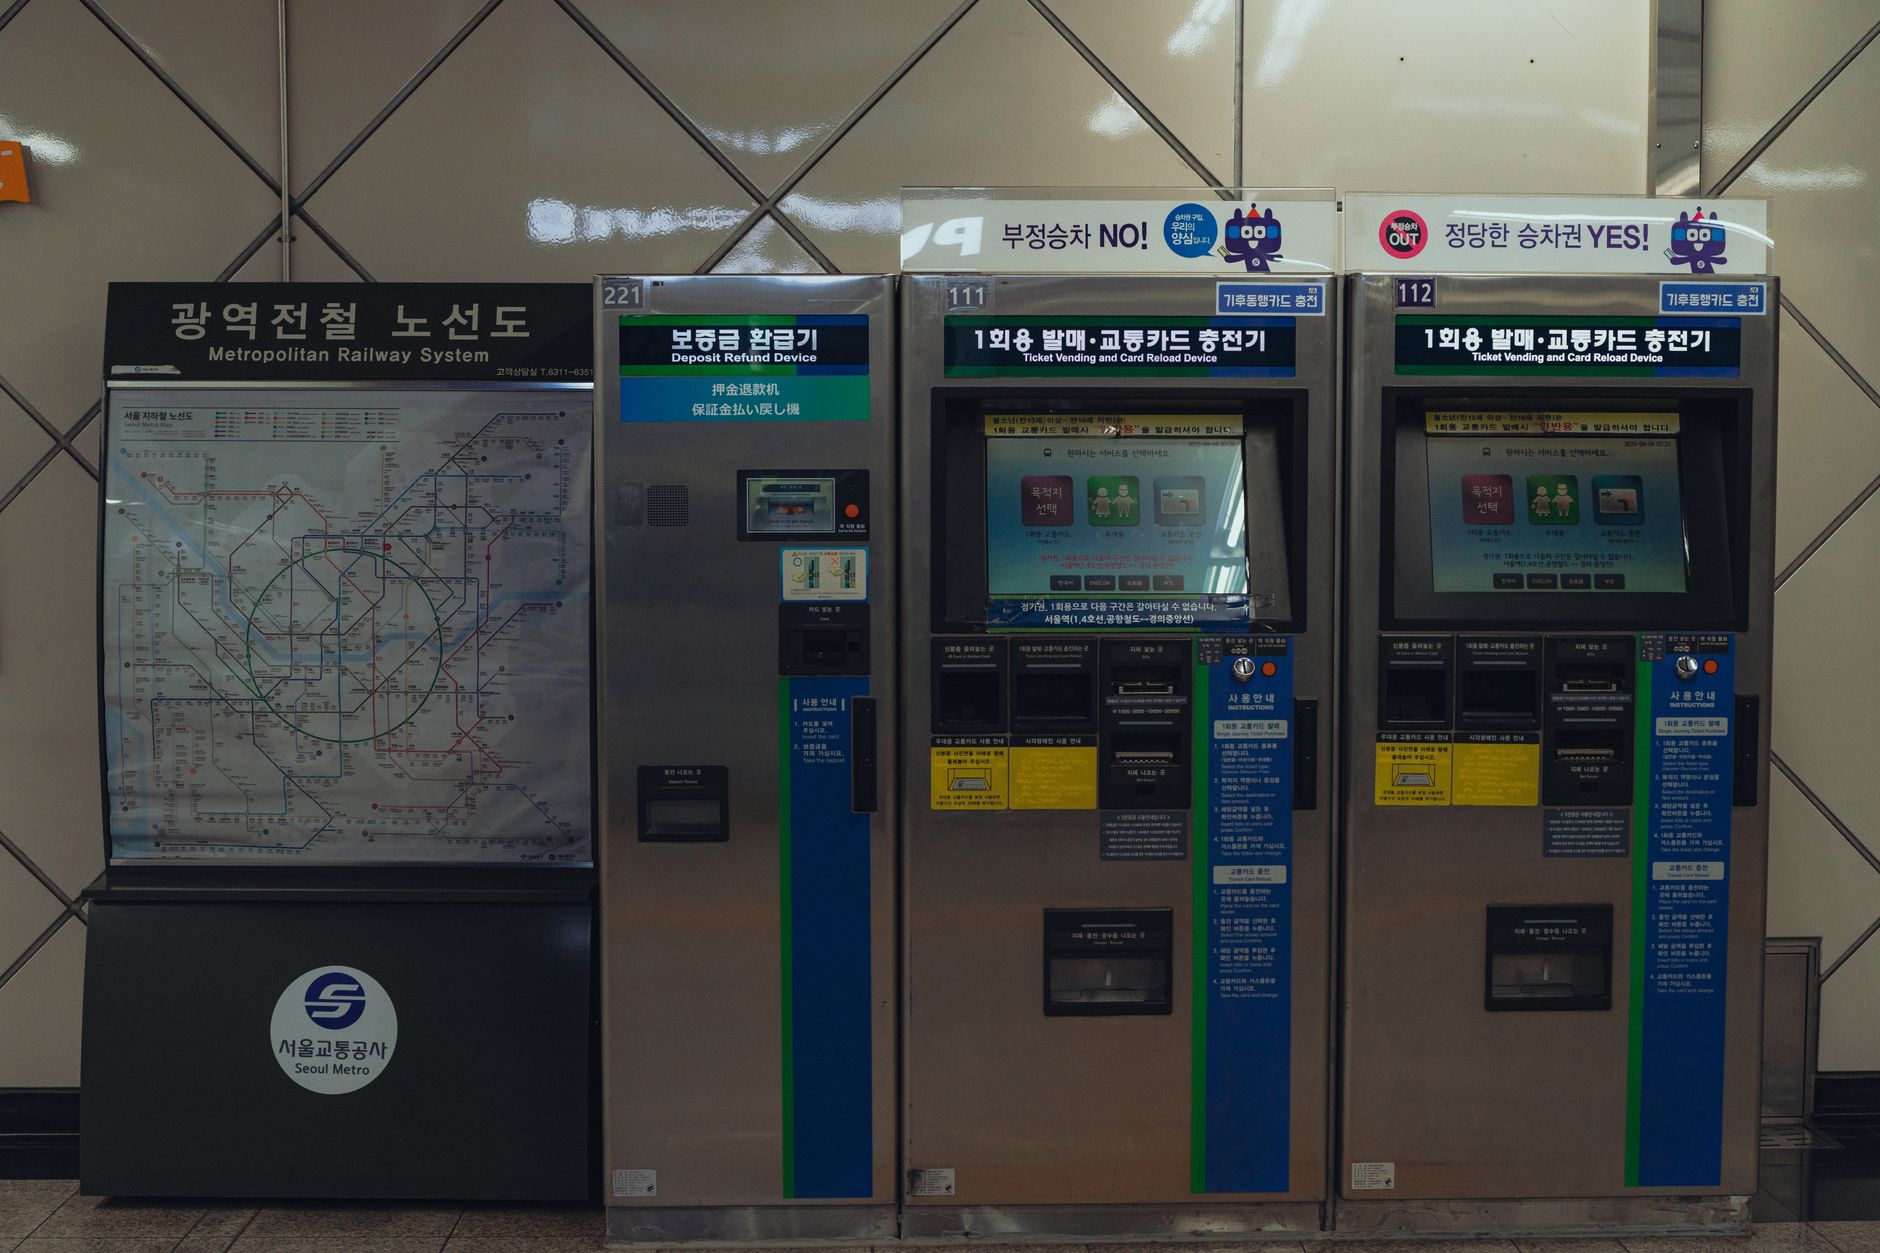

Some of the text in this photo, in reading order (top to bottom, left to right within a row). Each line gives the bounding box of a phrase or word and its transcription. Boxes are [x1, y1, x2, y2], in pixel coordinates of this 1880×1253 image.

[1171, 222, 1195, 232] 우리의
[1002, 222, 1148, 251] 부정승차 NO!
[1171, 232, 1211, 245] 양심입니다.
[1389, 233, 1419, 246] OUT
[1445, 222, 1649, 250] 정당한 승차권 YES!
[603, 287, 641, 305] 221
[949, 287, 985, 306] 111
[1398, 283, 1432, 303] 112
[1223, 294, 1318, 308] 기후동행카드 충전
[1667, 293, 1759, 308] 기후동행카드 충전
[170, 302, 531, 340] 광역전철 노선도
[671, 329, 818, 351] 보증금 환급기
[974, 328, 1266, 353] 1회용 발매·교통카드 충전기
[1424, 328, 1711, 353] 1회용 발매·교통카드 충전기
[208, 347, 490, 364] Metropolitan Railway System
[671, 352, 817, 365] Deposit Refund Device
[1023, 352, 1218, 365] Ticket Vending and Card Reload Device
[1472, 352, 1663, 364] Ticket Vending and Card Reload Device
[496, 368, 538, 377] 고객상담실
[711, 383, 780, 397] 押金退款机
[691, 402, 800, 417] 保証金払い戻し機
[124, 411, 194, 422] 서울 지하철 노선도
[994, 426, 1016, 434] 1회용
[1021, 426, 1057, 434] 교통카드
[1435, 423, 1457, 432] 1회용
[1462, 423, 1497, 432] 교통카드
[1643, 423, 1672, 432] 합니다.
[1030, 487, 1062, 499] 목적지
[1471, 485, 1503, 498] 목적지
[1035, 503, 1058, 516] 선택
[1476, 502, 1498, 514] 선택
[1051, 602, 1089, 612] 1회용으로
[1091, 602, 1107, 612] 다음
[1109, 602, 1134, 612] 구간은
[1136, 602, 1169, 612] 갈아타실
[1171, 602, 1180, 612] 수
[1182, 602, 1217, 612] 없습니다.
[802, 698, 837, 707] 사용 안내
[278, 1038, 388, 1061] 서울교통공사
[295, 1063, 370, 1075] Seoul Metro
